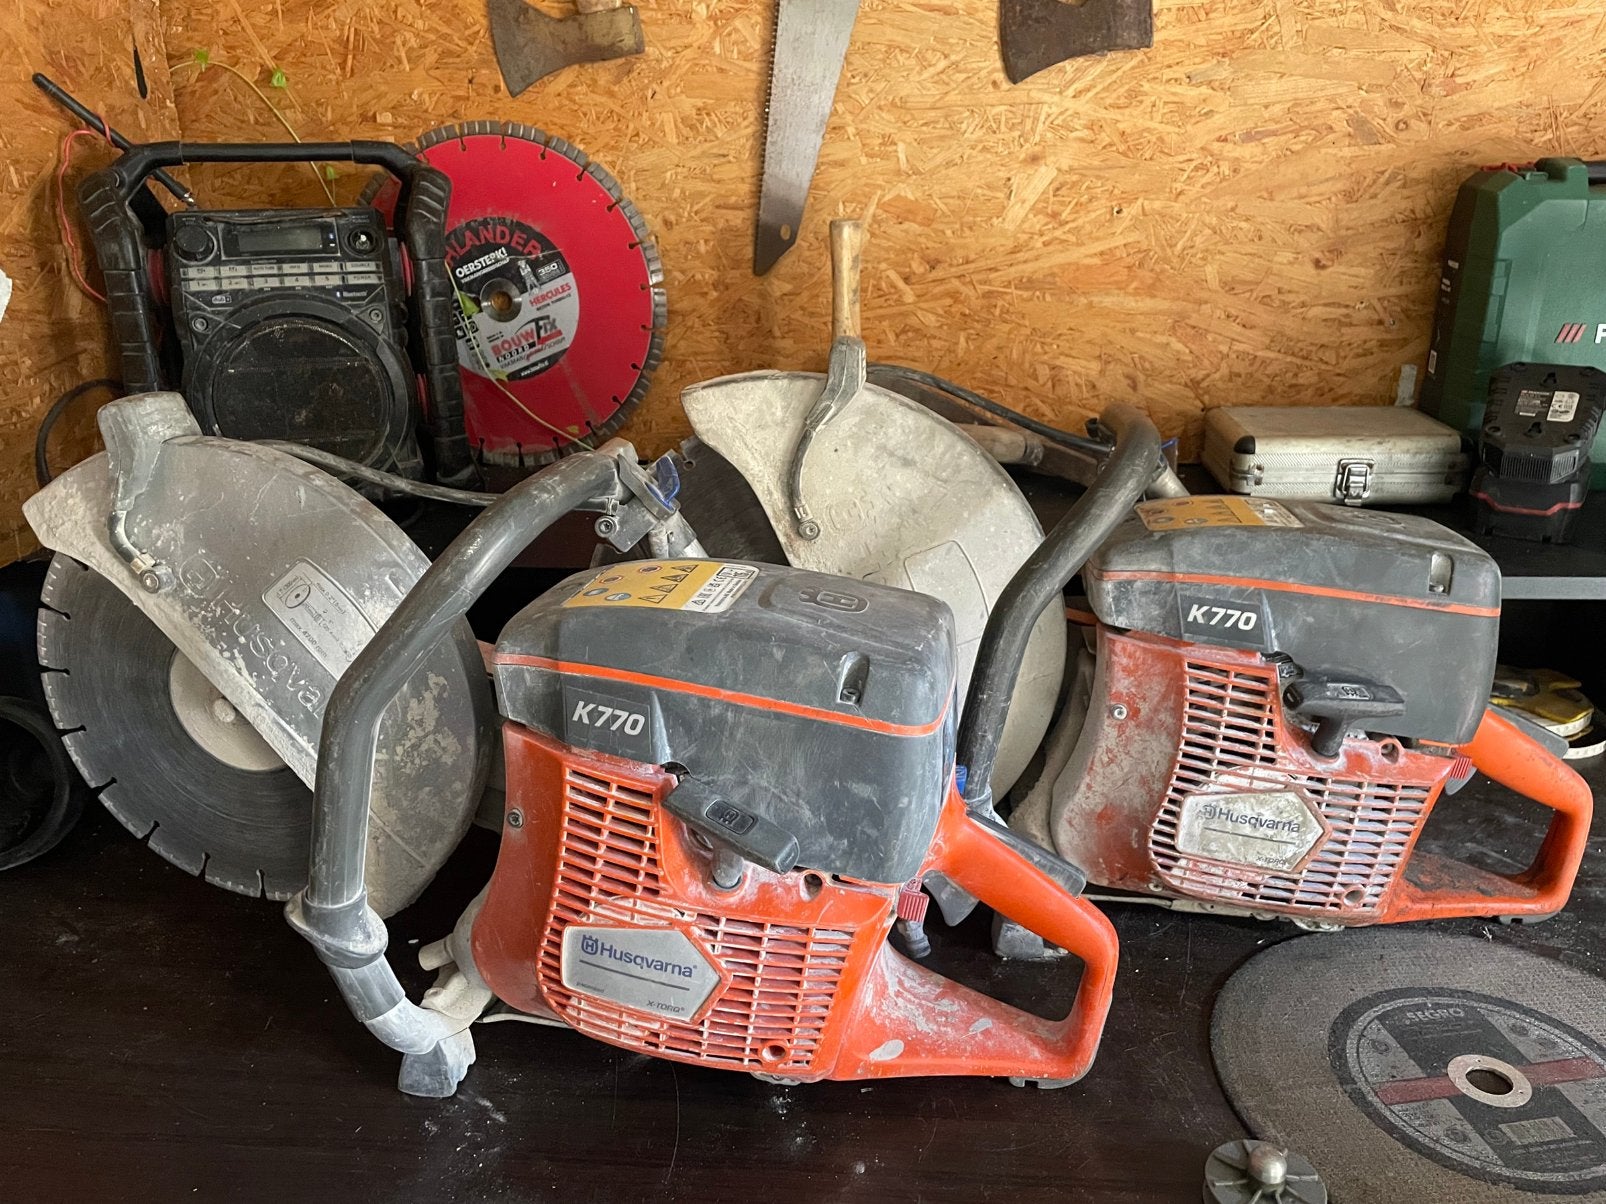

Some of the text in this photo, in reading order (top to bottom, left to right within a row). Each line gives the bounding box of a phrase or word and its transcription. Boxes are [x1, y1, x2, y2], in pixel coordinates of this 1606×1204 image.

[529, 282, 572, 308] HERCULES
[1187, 604, 1258, 631] K770
[301, 629, 317, 646] 4700
[209, 591, 324, 719] Husqva
[571, 700, 646, 737] K770
[1218, 807, 1301, 833] Husqvarna
